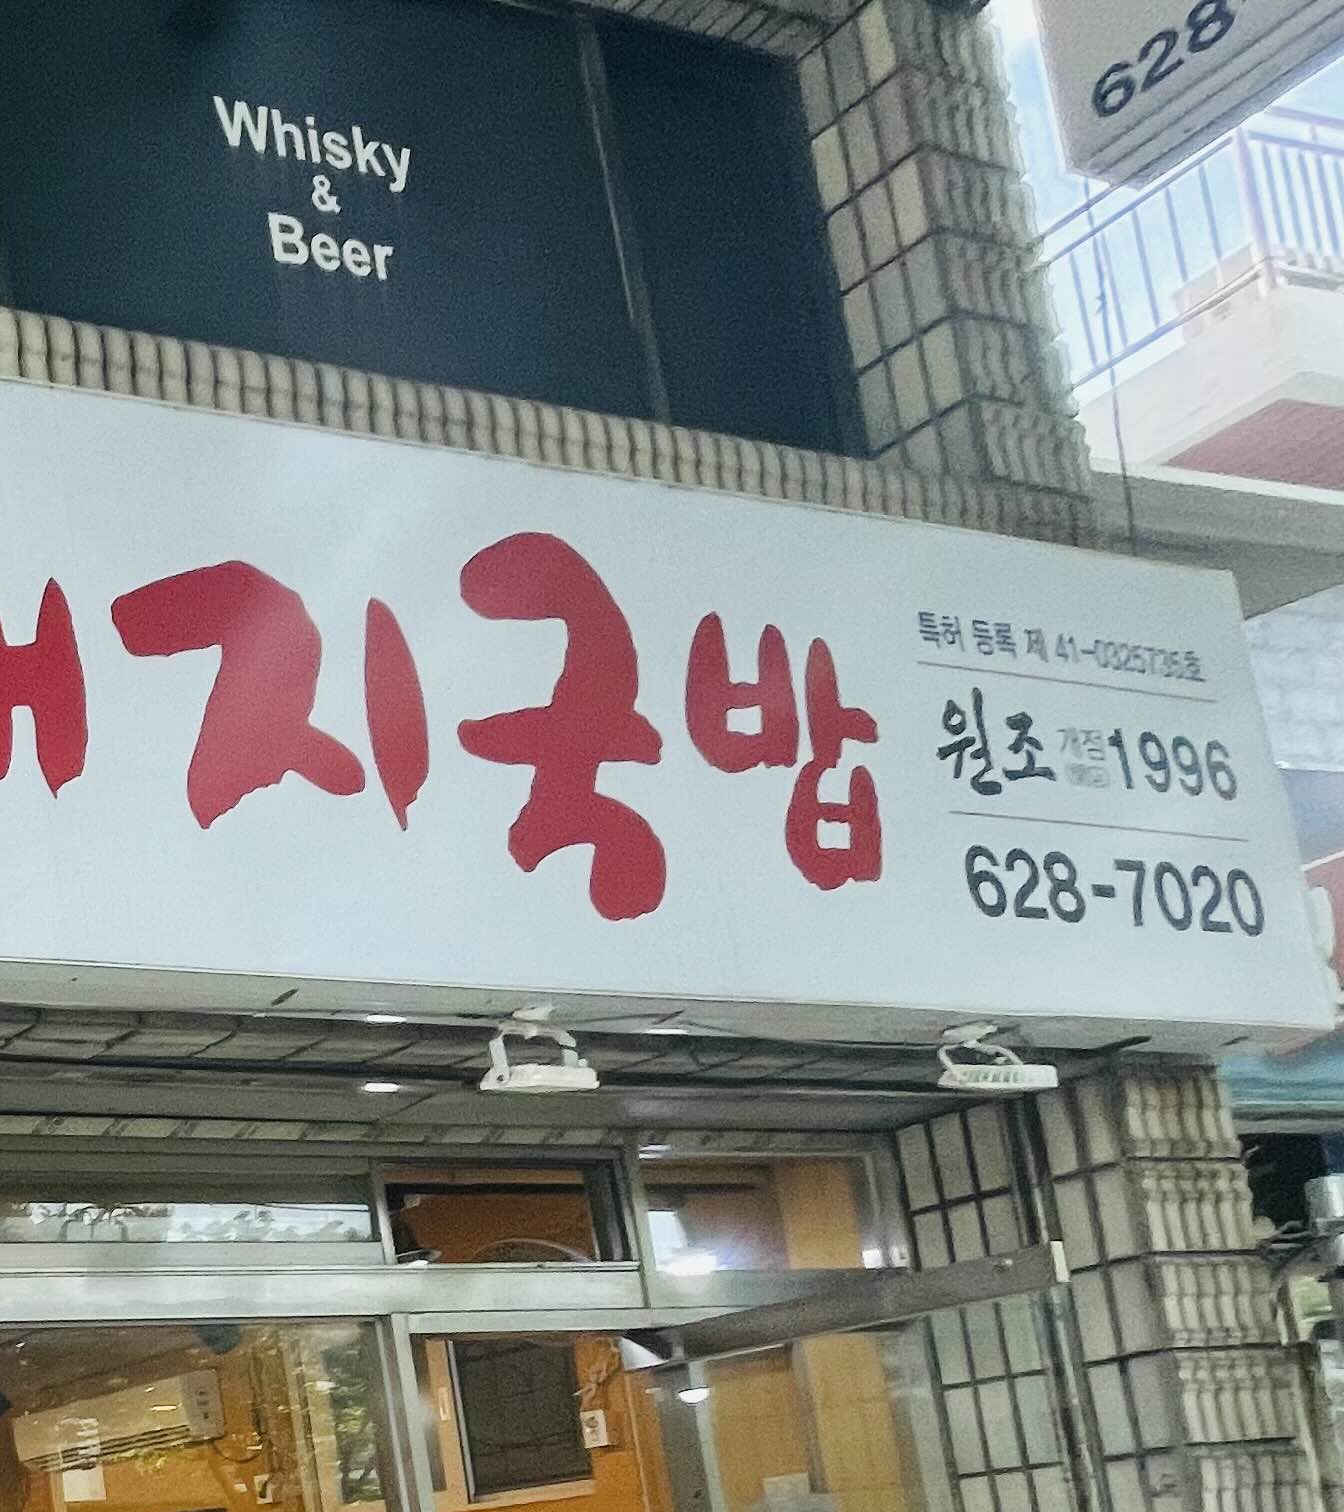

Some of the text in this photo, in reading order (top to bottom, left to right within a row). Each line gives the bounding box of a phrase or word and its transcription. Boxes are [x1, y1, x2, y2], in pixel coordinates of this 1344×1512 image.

[1092, 0, 1235, 118] 628
[213, 96, 410, 192] Whisky
[312, 175, 341, 213] &
[268, 212, 394, 281] Beer
[937, 688, 1055, 796] 원조
[1108, 729, 1237, 801] 1996
[965, 845, 1265, 937] 628-7020
